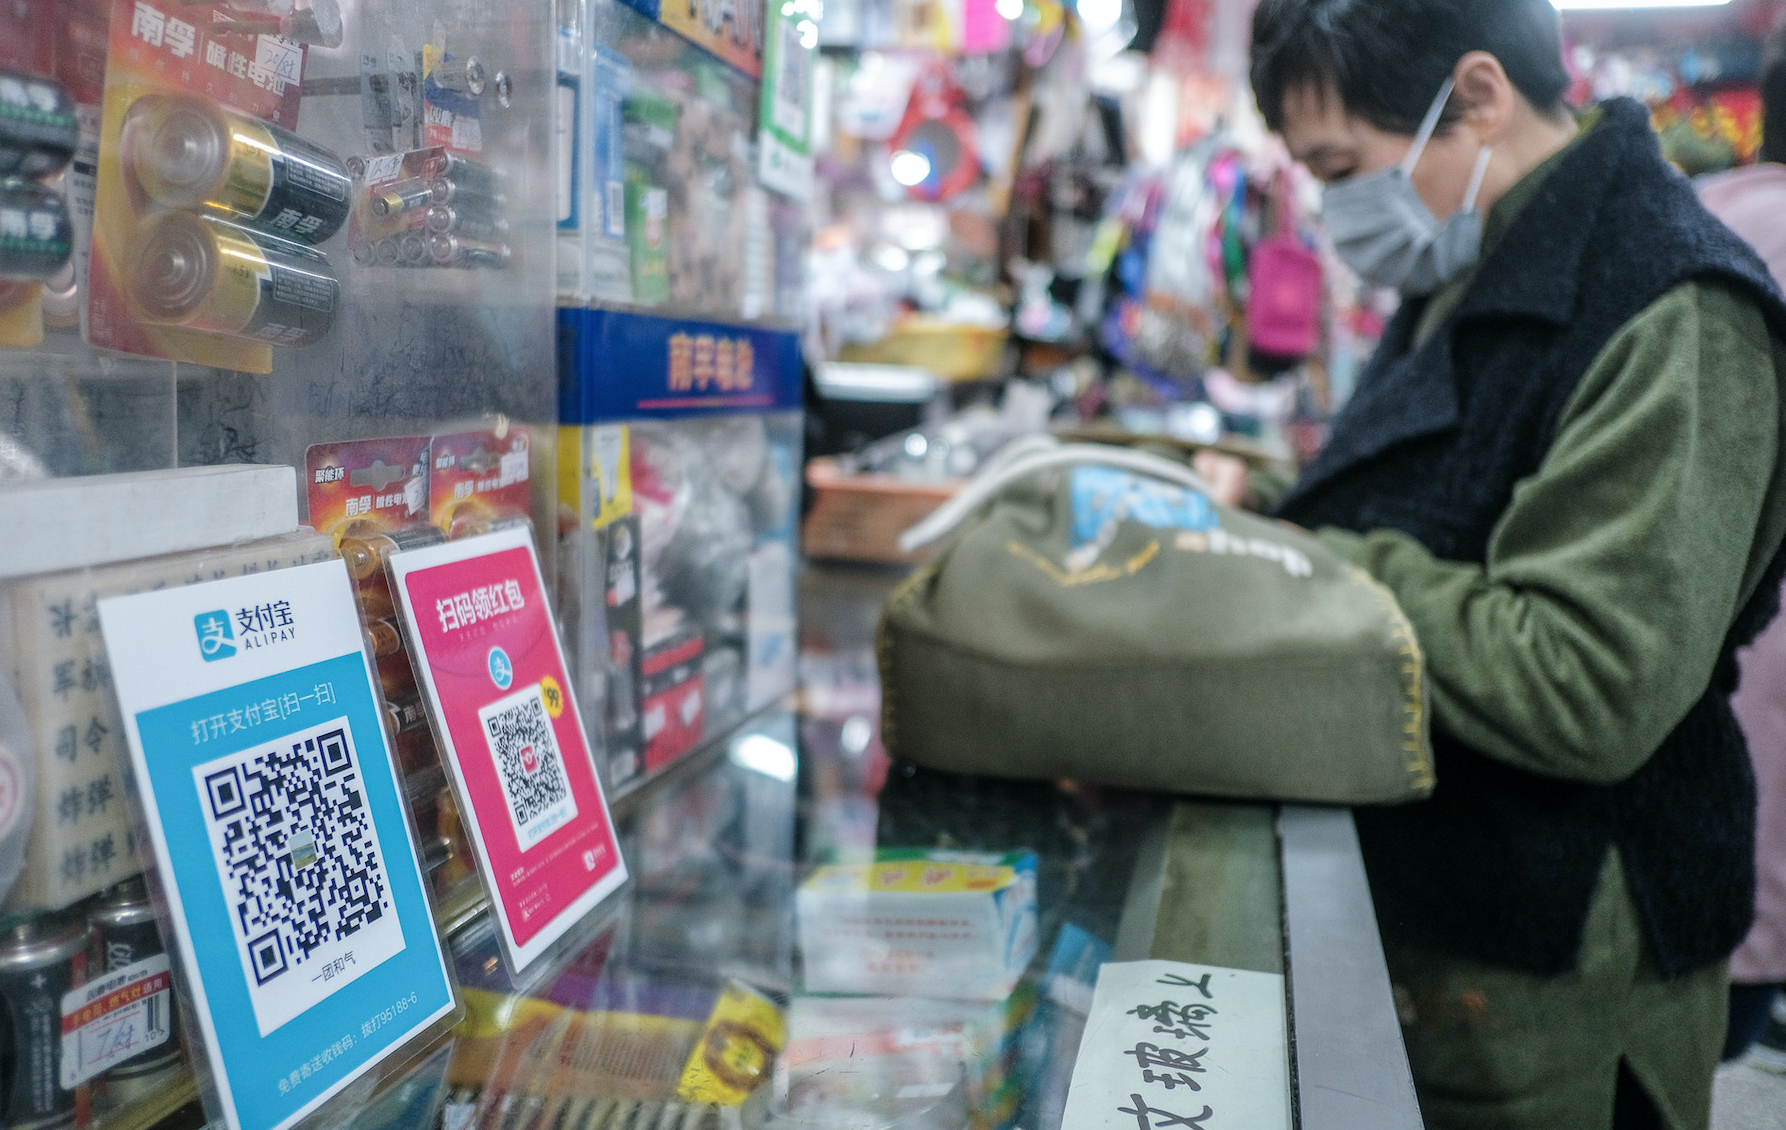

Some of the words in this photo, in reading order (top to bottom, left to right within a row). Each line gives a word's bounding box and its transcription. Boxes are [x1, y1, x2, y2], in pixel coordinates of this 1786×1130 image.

[131, 1, 195, 58] 南孚
[269, 207, 324, 234] 南孚
[314, 466, 345, 484] 聚能环
[345, 494, 372, 518] 南孚
[235, 600, 295, 636] 支付宝
[436, 579, 525, 633] 扫码领红包
[245, 627, 296, 650] ALIPAY
[191, 682, 337, 746] 打开支付宝[扫一扫]
[311, 950, 357, 983] 一团和气
